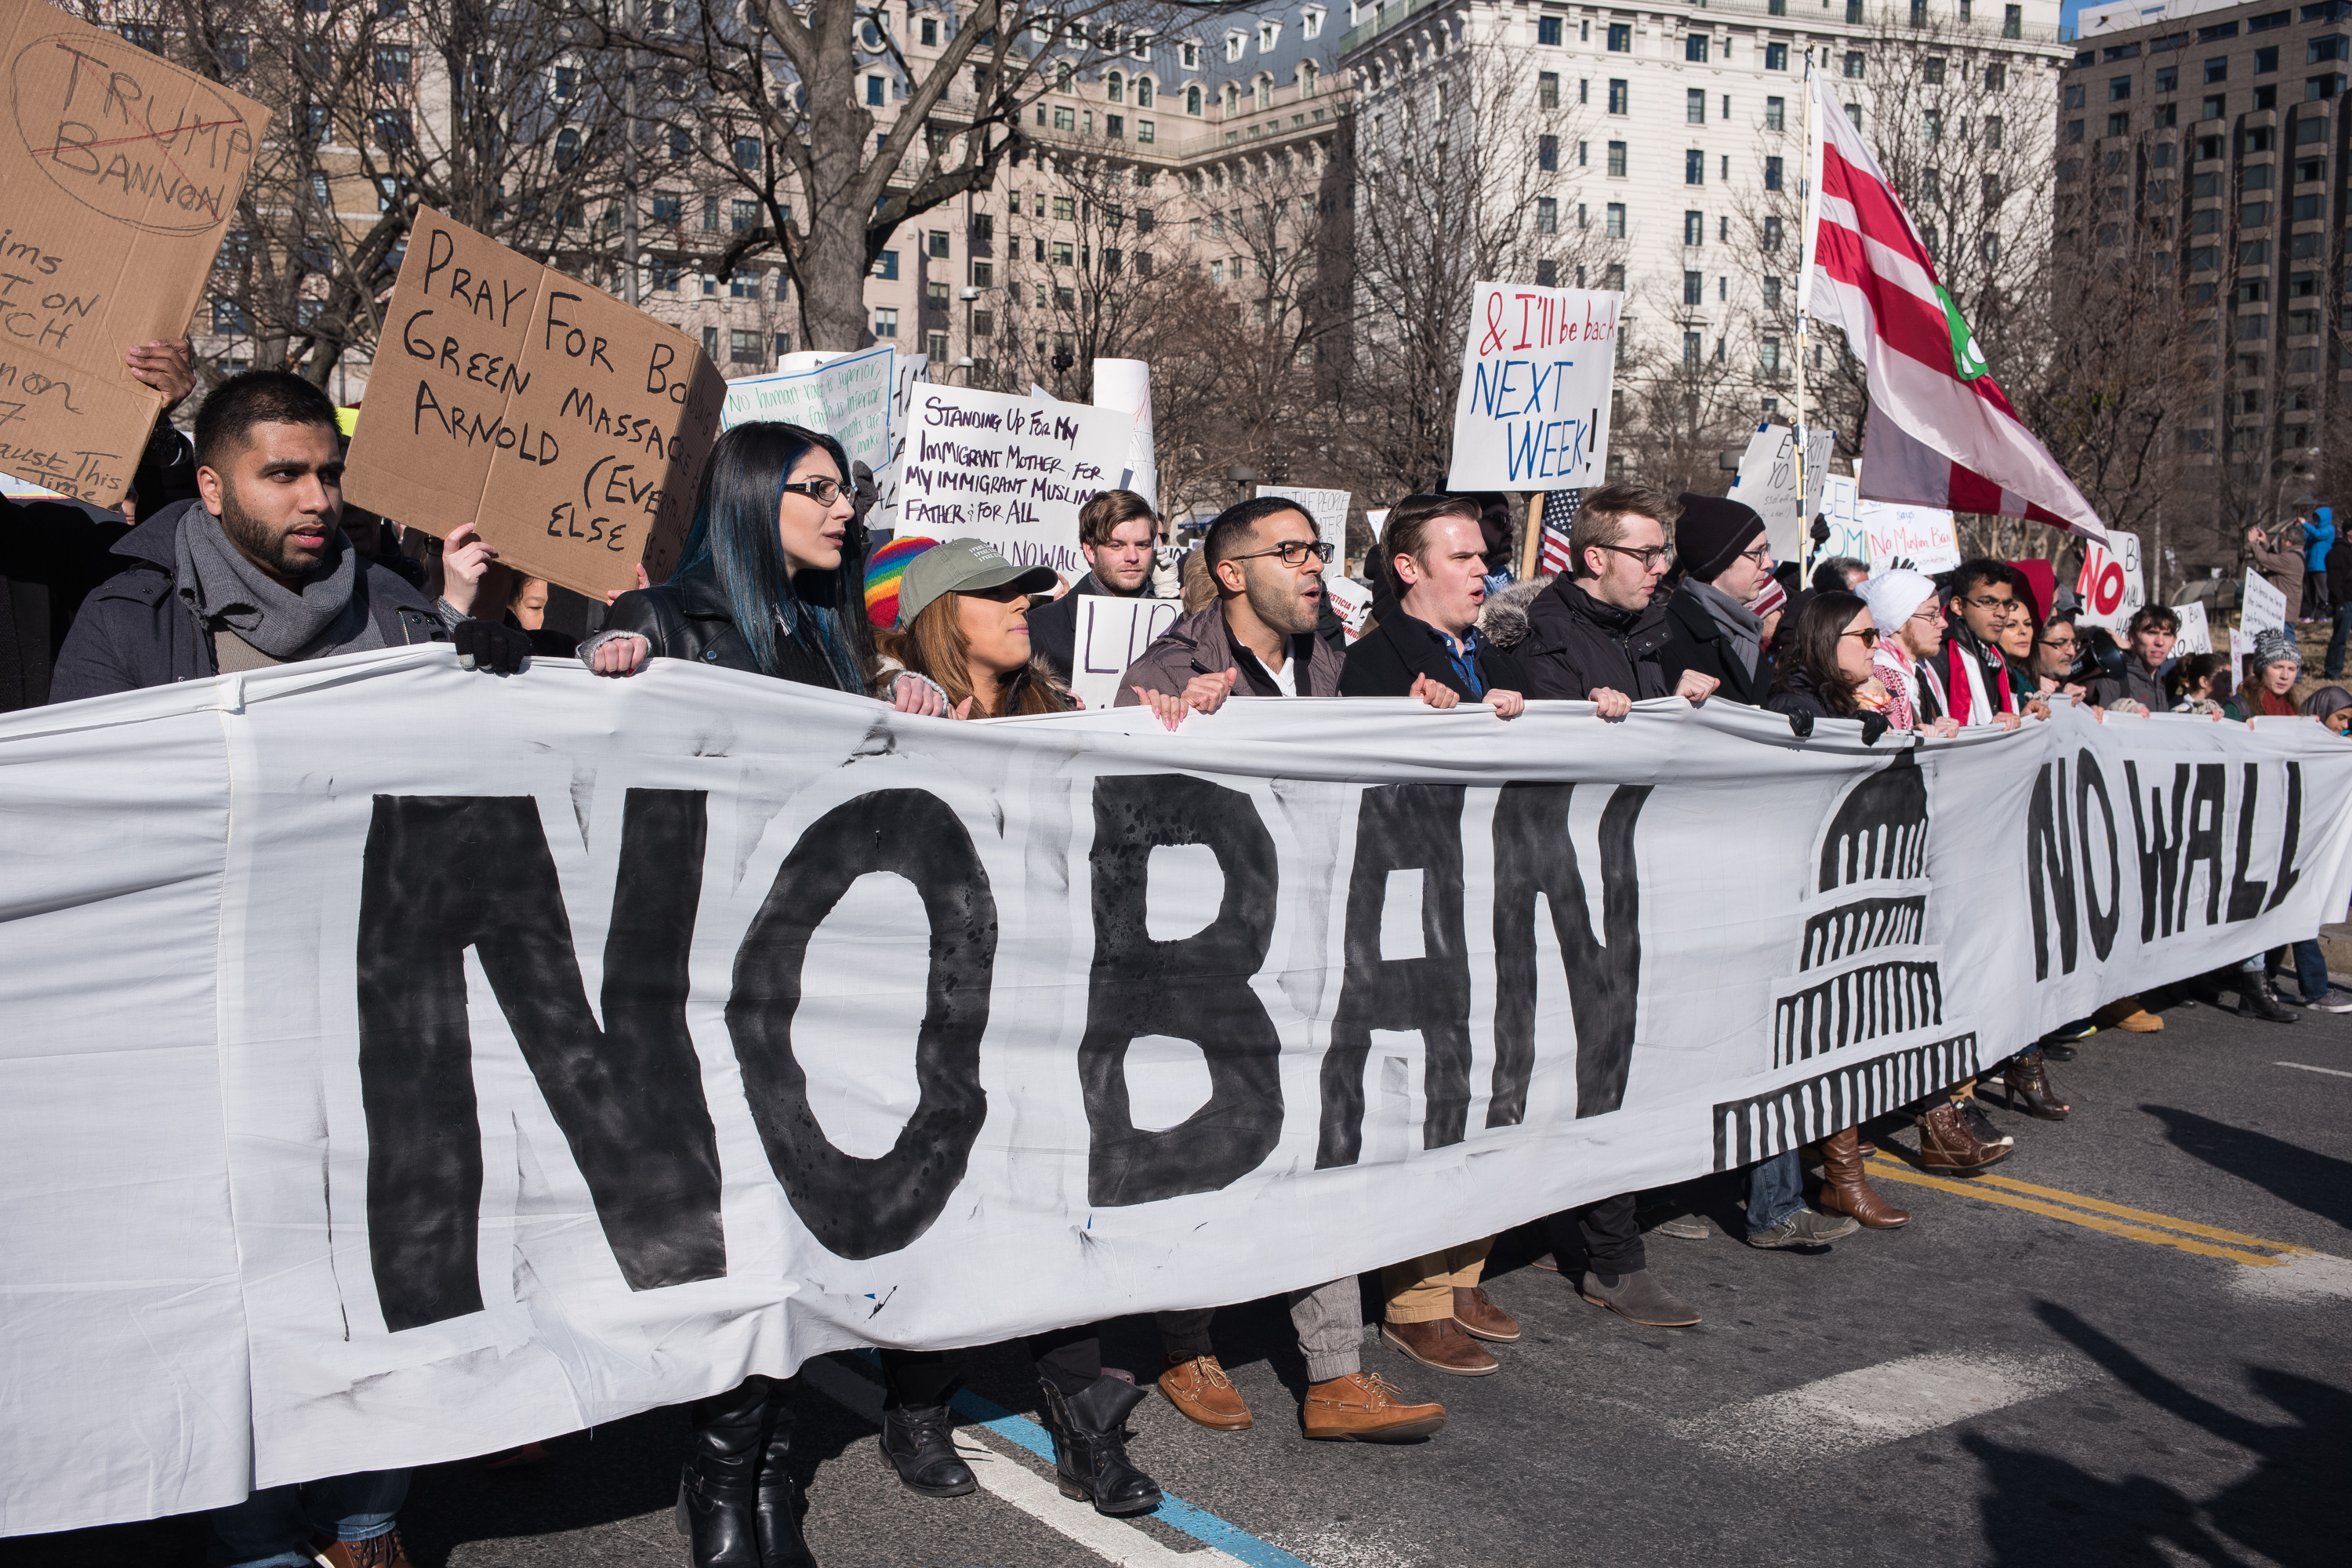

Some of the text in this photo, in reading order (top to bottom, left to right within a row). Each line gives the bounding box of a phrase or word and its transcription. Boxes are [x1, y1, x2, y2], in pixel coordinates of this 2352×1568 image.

[56, 44, 252, 173] TRUMP
[52, 121, 225, 220] BANNON
[0, 228, 63, 274] ims
[42, 293, 101, 318] ON
[423, 229, 528, 328] PRAY
[545, 291, 615, 374] FOR
[1479, 292, 1615, 357] & I'll be back
[0, 362, 84, 416] non
[403, 309, 531, 395] GREEN
[559, 387, 692, 477] MASSACRE
[755, 387, 800, 409] human
[804, 383, 825, 401] race
[826, 376, 833, 394] is
[1470, 359, 1574, 421] NEXT
[414, 379, 559, 466] ARNOLD
[807, 401, 834, 429] faith
[837, 401, 844, 419] is
[866, 413, 880, 430] are
[924, 395, 1003, 433] STANDING
[1029, 410, 1051, 437] FOR
[1054, 416, 1080, 451] MY
[0, 443, 122, 490] aust This
[857, 431, 881, 454] make
[920, 429, 1003, 469] IMMIGRANT
[1072, 462, 1105, 481] FOR
[1508, 408, 1599, 482] WEEK!
[905, 465, 1097, 506] MY IMMIGRANT MUSLIM
[1317, 491, 1351, 513] PEOPLE
[547, 503, 627, 551] ELSE
[905, 498, 967, 524] FATHER
[977, 502, 1004, 524] FOR
[1004, 499, 1040, 525] ALL
[1314, 514, 1344, 535] ATER
[1896, 510, 1915, 524] says
[1871, 525, 1951, 556] No Muslim Ban
[1327, 590, 1352, 611] USTICIA
[2075, 543, 2125, 616] NO
[2027, 747, 2302, 983] NO WALL
[356, 773, 1655, 1334] NO BAN
